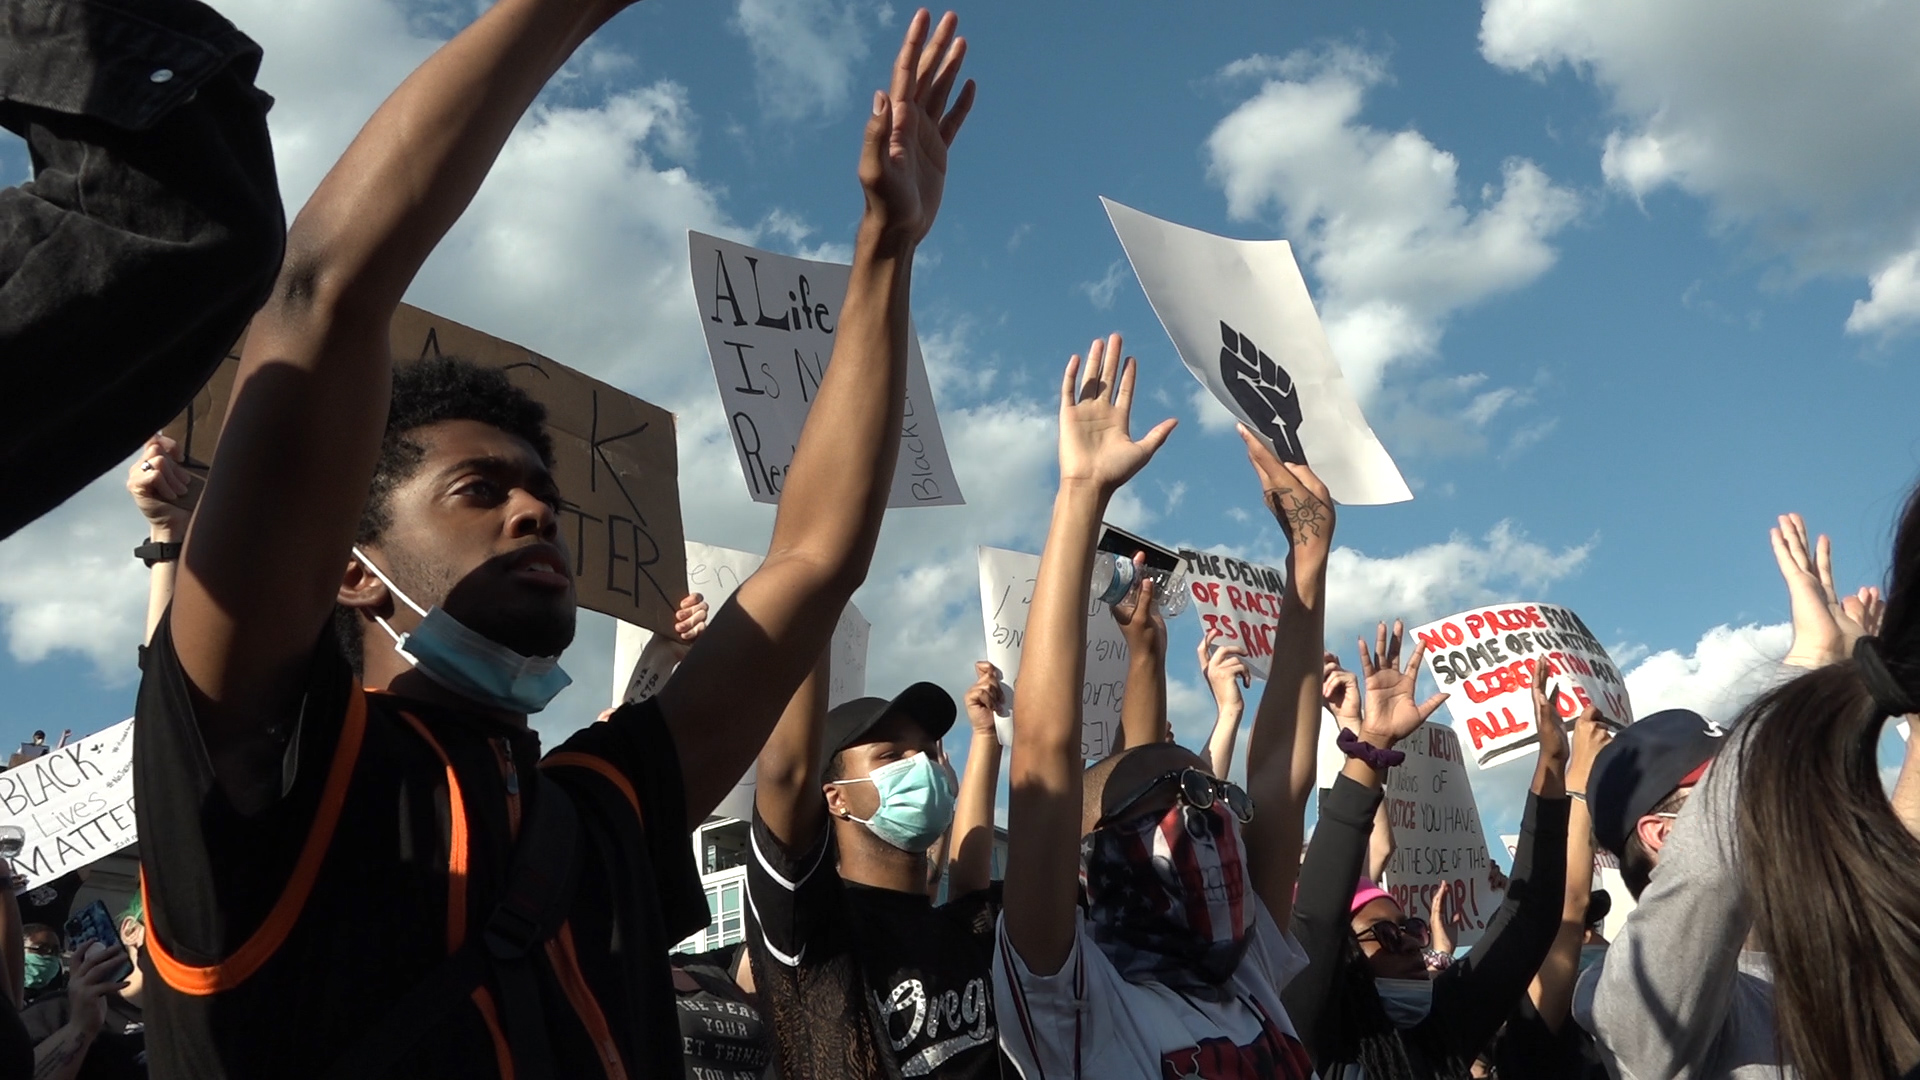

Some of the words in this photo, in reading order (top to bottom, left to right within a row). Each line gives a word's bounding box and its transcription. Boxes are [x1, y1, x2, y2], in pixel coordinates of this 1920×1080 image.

[744, 255, 834, 334] Life
[723, 340, 781, 399] Is
[1179, 550, 1226, 579] THE
[1191, 581, 1221, 607] OF
[1203, 614, 1238, 639] IS
[1418, 621, 1465, 653] NO
[1464, 606, 1547, 639] PRIDE
[1538, 605, 1581, 633] FOR
[1432, 636, 1509, 685] SOME
[1504, 632, 1534, 655] OF
[1532, 629, 1564, 651] US
[1466, 706, 1529, 750] ALL
[1555, 685, 1593, 718] OF
[1603, 690, 1630, 724] US
[0, 742, 104, 816] BLACK
[1432, 769, 1448, 793] OF
[31, 791, 108, 838] Lives
[1420, 802, 1441, 832] YOU
[1444, 806, 1476, 834] HAVE
[1424, 846, 1449, 875] SIDE
[1452, 848, 1462, 869] OF
[1466, 846, 1486, 870] THE
[702, 1016, 748, 1036] YOUR
